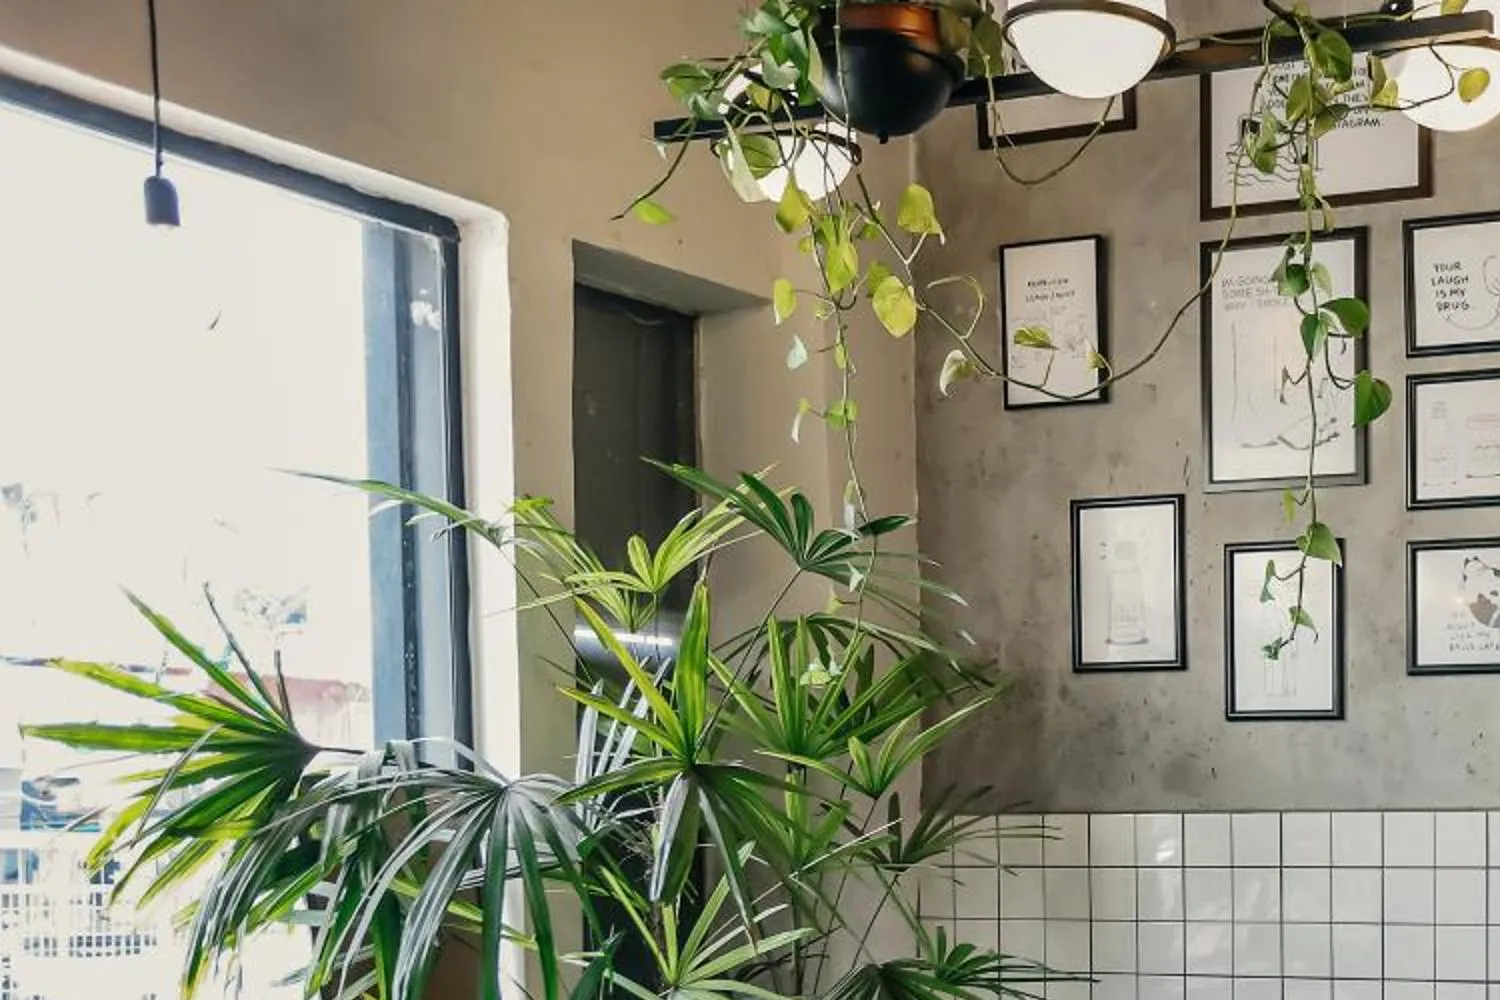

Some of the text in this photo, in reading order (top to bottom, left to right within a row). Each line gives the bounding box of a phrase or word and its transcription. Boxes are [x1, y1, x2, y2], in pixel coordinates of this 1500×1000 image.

[1433, 261, 1463, 273] YOUR
[1431, 274, 1469, 287] LAUGH
[1435, 287, 1466, 299] IS MY
[1435, 300, 1471, 312] DRUG
